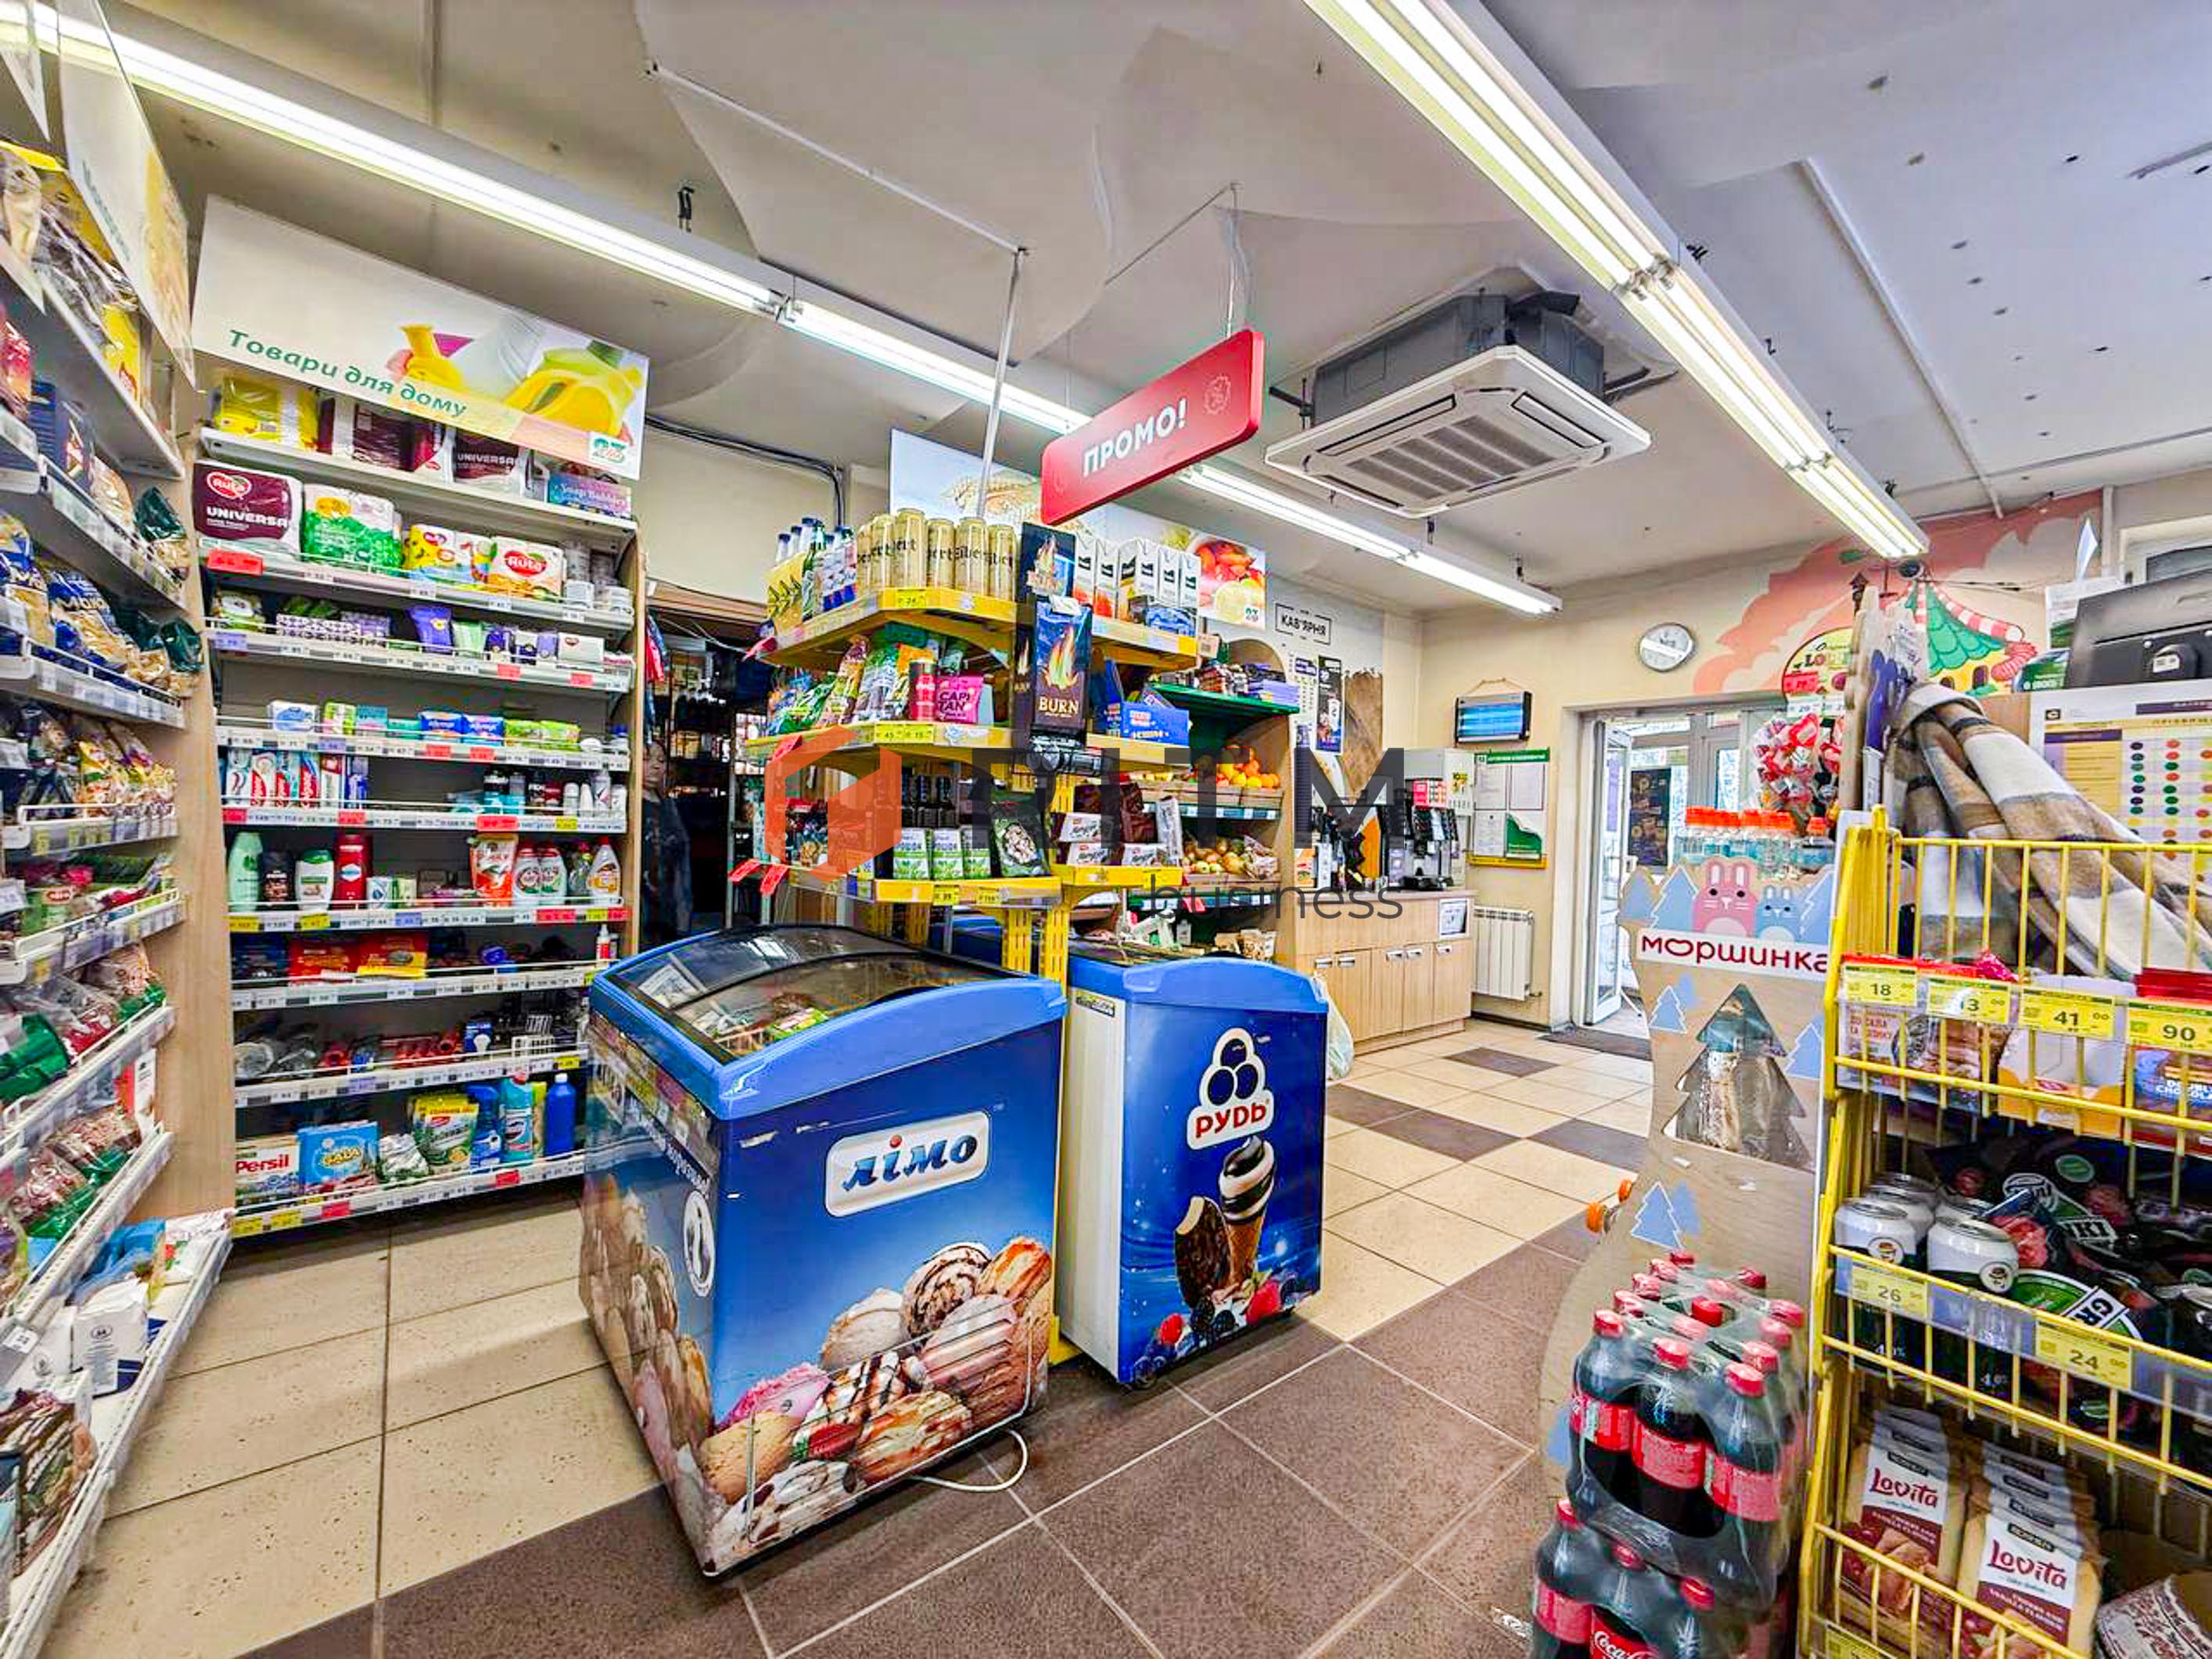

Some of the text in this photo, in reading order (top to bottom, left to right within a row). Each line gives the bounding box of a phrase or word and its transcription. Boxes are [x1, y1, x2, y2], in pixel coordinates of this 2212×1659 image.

[230, 329, 467, 417] Товари для дому
[1083, 397, 1187, 478] ПРОМО!
[457, 453, 515, 467] UNIVERSA
[206, 505, 288, 528] UNIVERSA
[508, 555, 543, 570] Ruta
[1280, 612, 1327, 637] КАВ'ЯРНЯ
[1038, 695, 1079, 714] BURN
[1870, 983, 1891, 996] 18
[2054, 1011, 2078, 1025] 41
[2163, 1024, 2196, 1041] 90
[1195, 1103, 1267, 1140] РУДЬ
[235, 1154, 289, 1173] Persil
[842, 1133, 978, 1192] лімо
[1878, 1284, 1901, 1303] 26
[2069, 1349, 2099, 1370] 24
[1869, 1467, 1938, 1508] Lovita
[1988, 1539, 2067, 1591] Lovita
